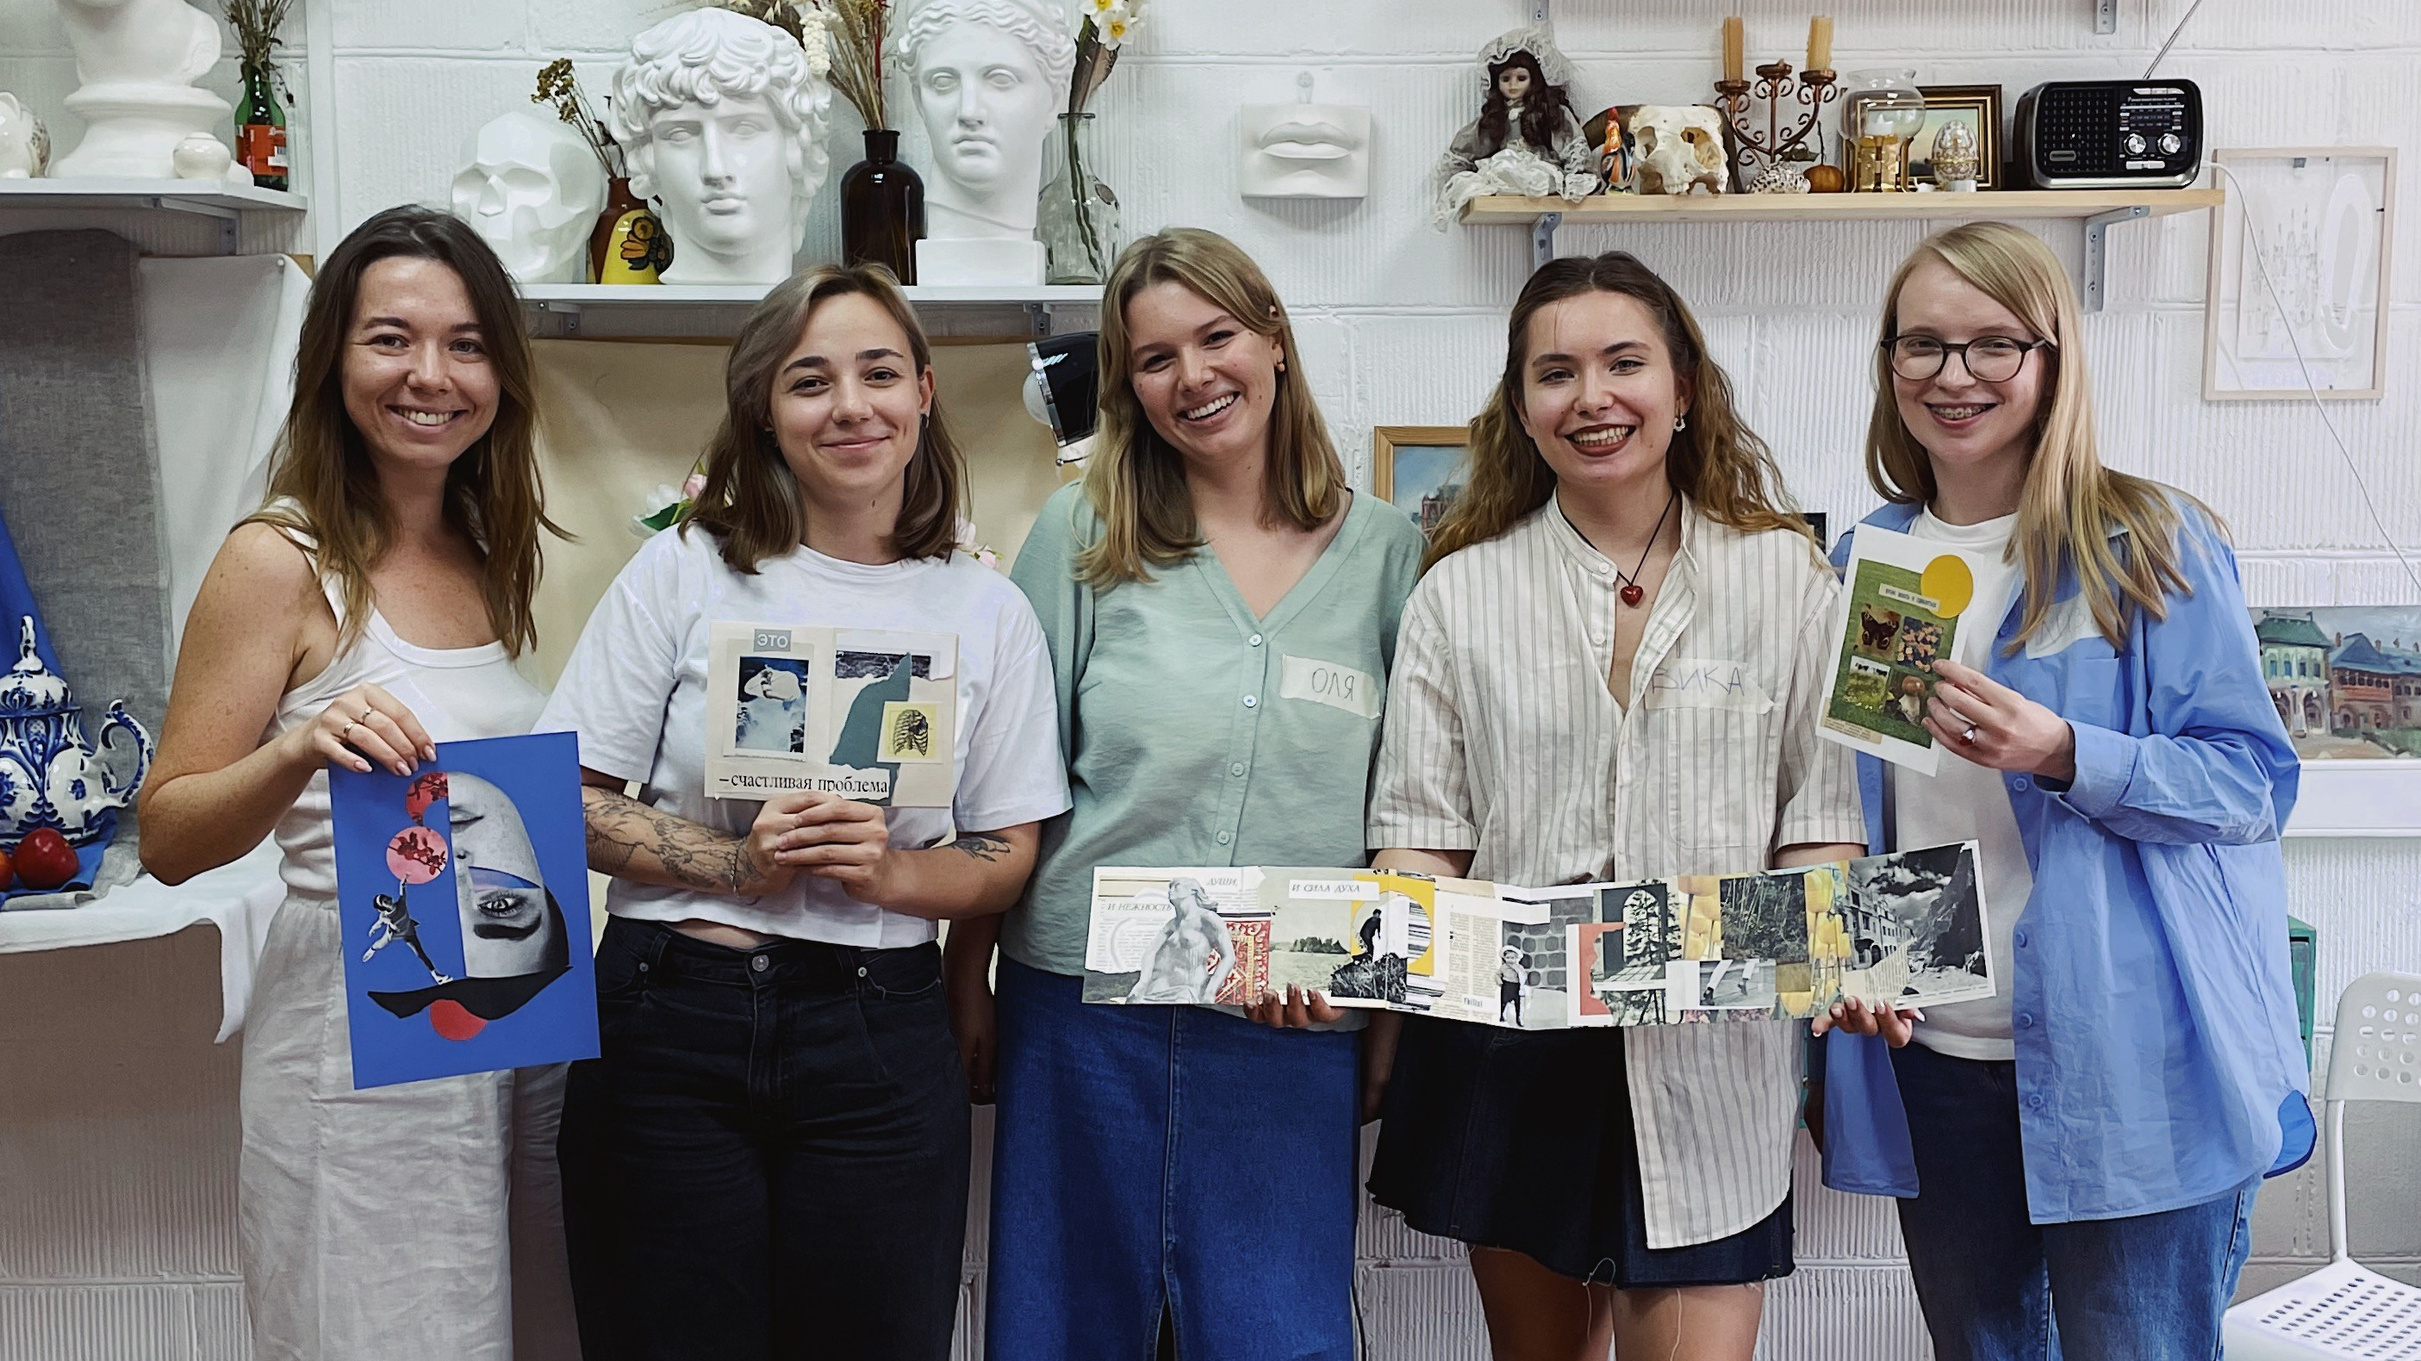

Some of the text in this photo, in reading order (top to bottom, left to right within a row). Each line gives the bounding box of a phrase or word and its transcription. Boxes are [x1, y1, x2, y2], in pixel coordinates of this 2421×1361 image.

[757, 633, 789, 649] ЭТО
[1311, 667, 1355, 702] ОЛЯ
[1651, 666, 1745, 697] ВИКА
[818, 777, 888, 793] проблема
[1291, 884, 1360, 893] И СИЛА ДУХА
[1107, 903, 1116, 911] И
[1118, 902, 1172, 912] НЕЖНОСТЬ
